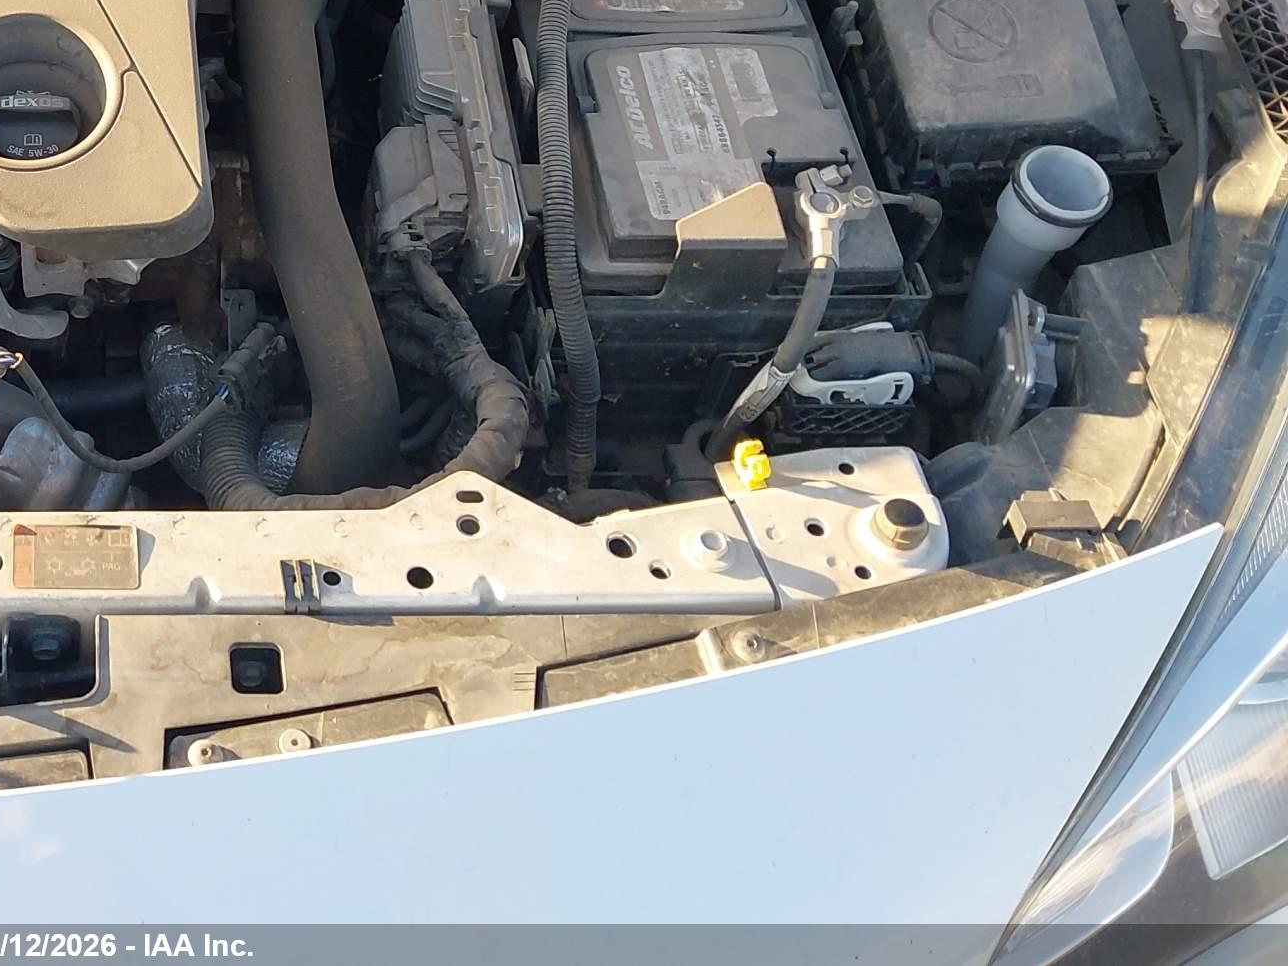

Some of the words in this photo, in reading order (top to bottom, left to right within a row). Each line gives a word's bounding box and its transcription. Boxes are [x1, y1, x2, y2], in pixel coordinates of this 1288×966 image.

[1, 96, 64, 108] dexos
[615, 65, 653, 149] ACDelco
[7, 145, 25, 156] SAE
[28, 144, 59, 157] 5W-30
